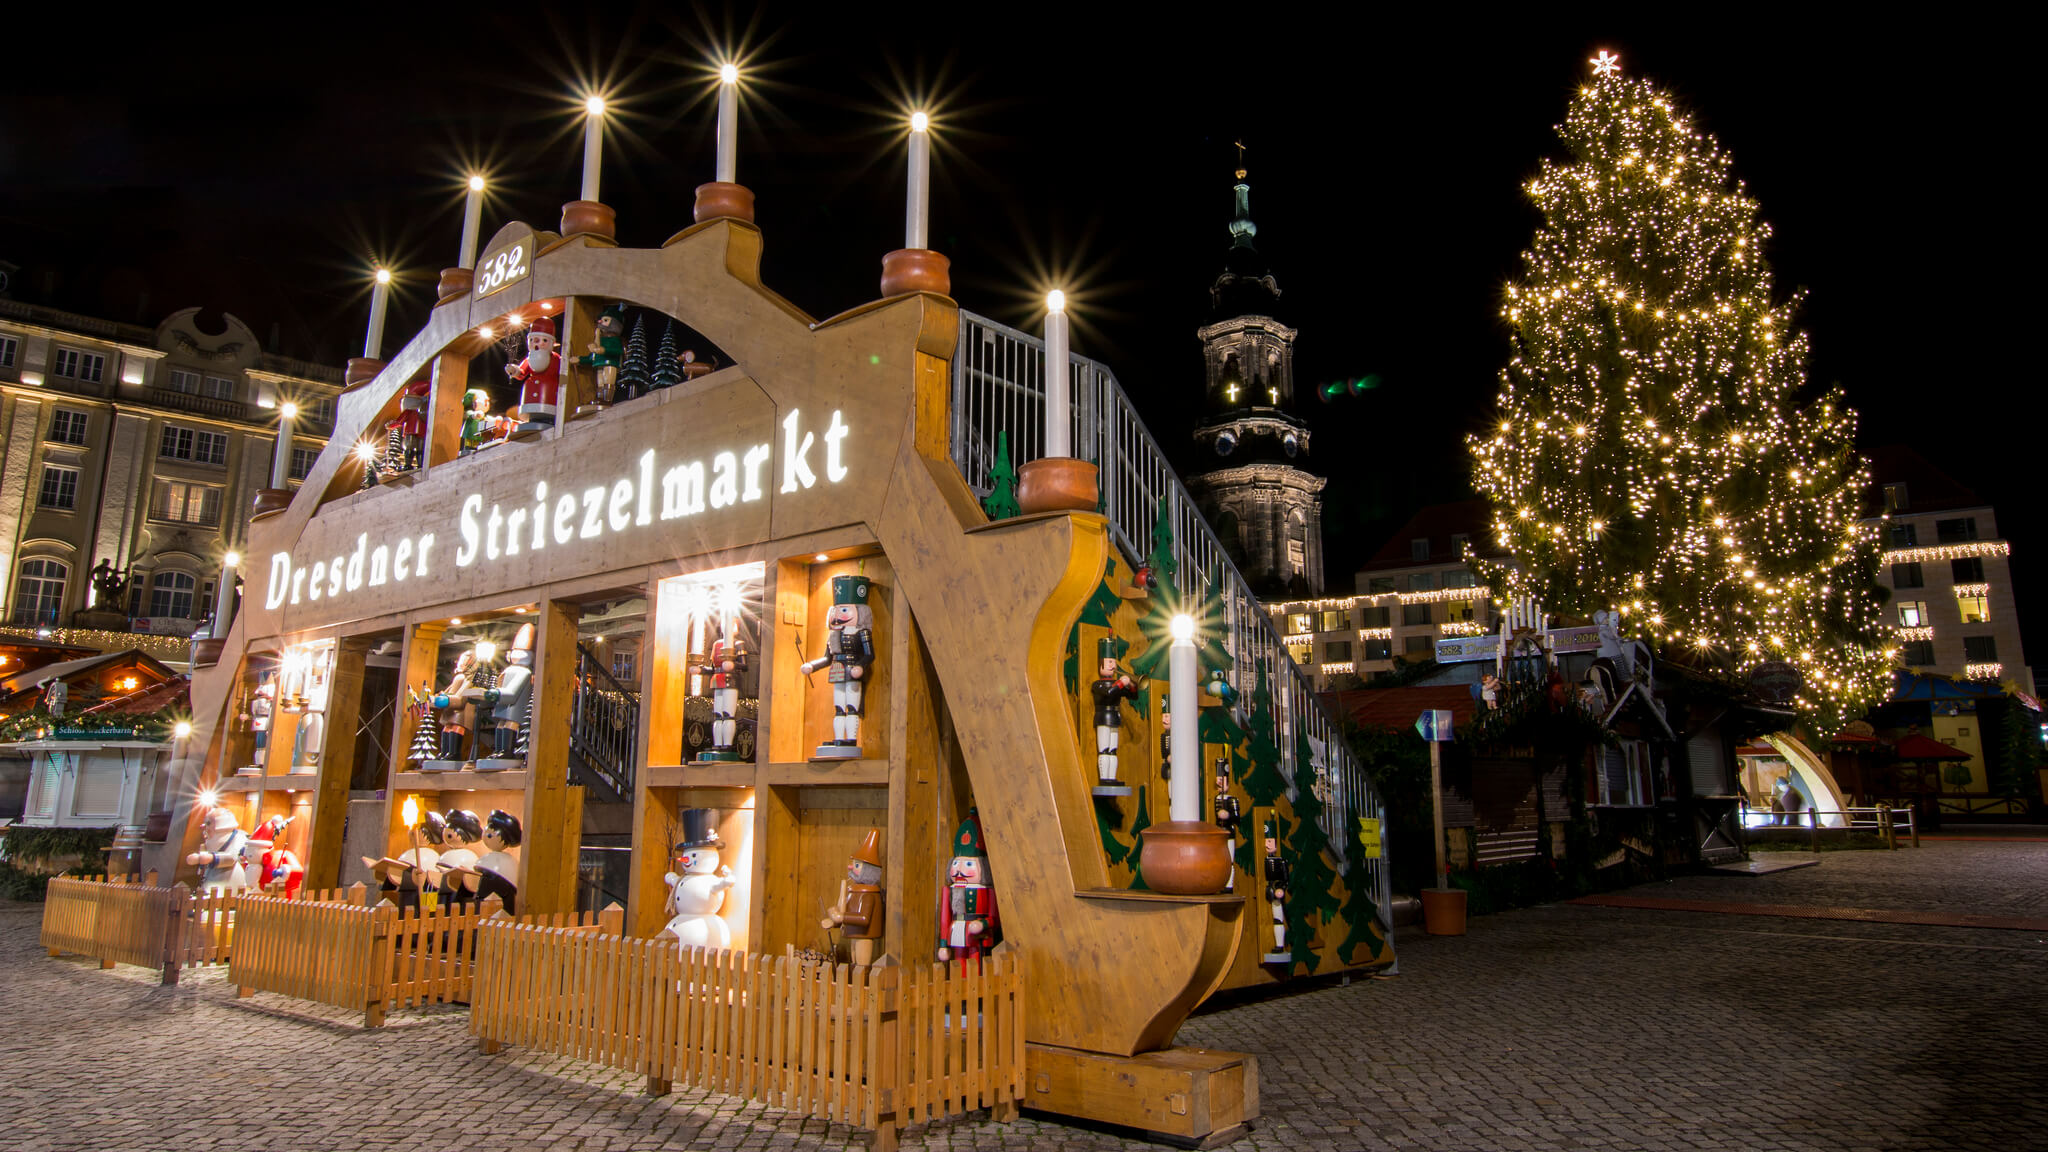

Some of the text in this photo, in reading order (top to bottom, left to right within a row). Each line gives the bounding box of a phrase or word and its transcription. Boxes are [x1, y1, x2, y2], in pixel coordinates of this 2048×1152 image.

[479, 245, 526, 293] 582.
[265, 408, 848, 610] Dresdner Striezelmarkt
